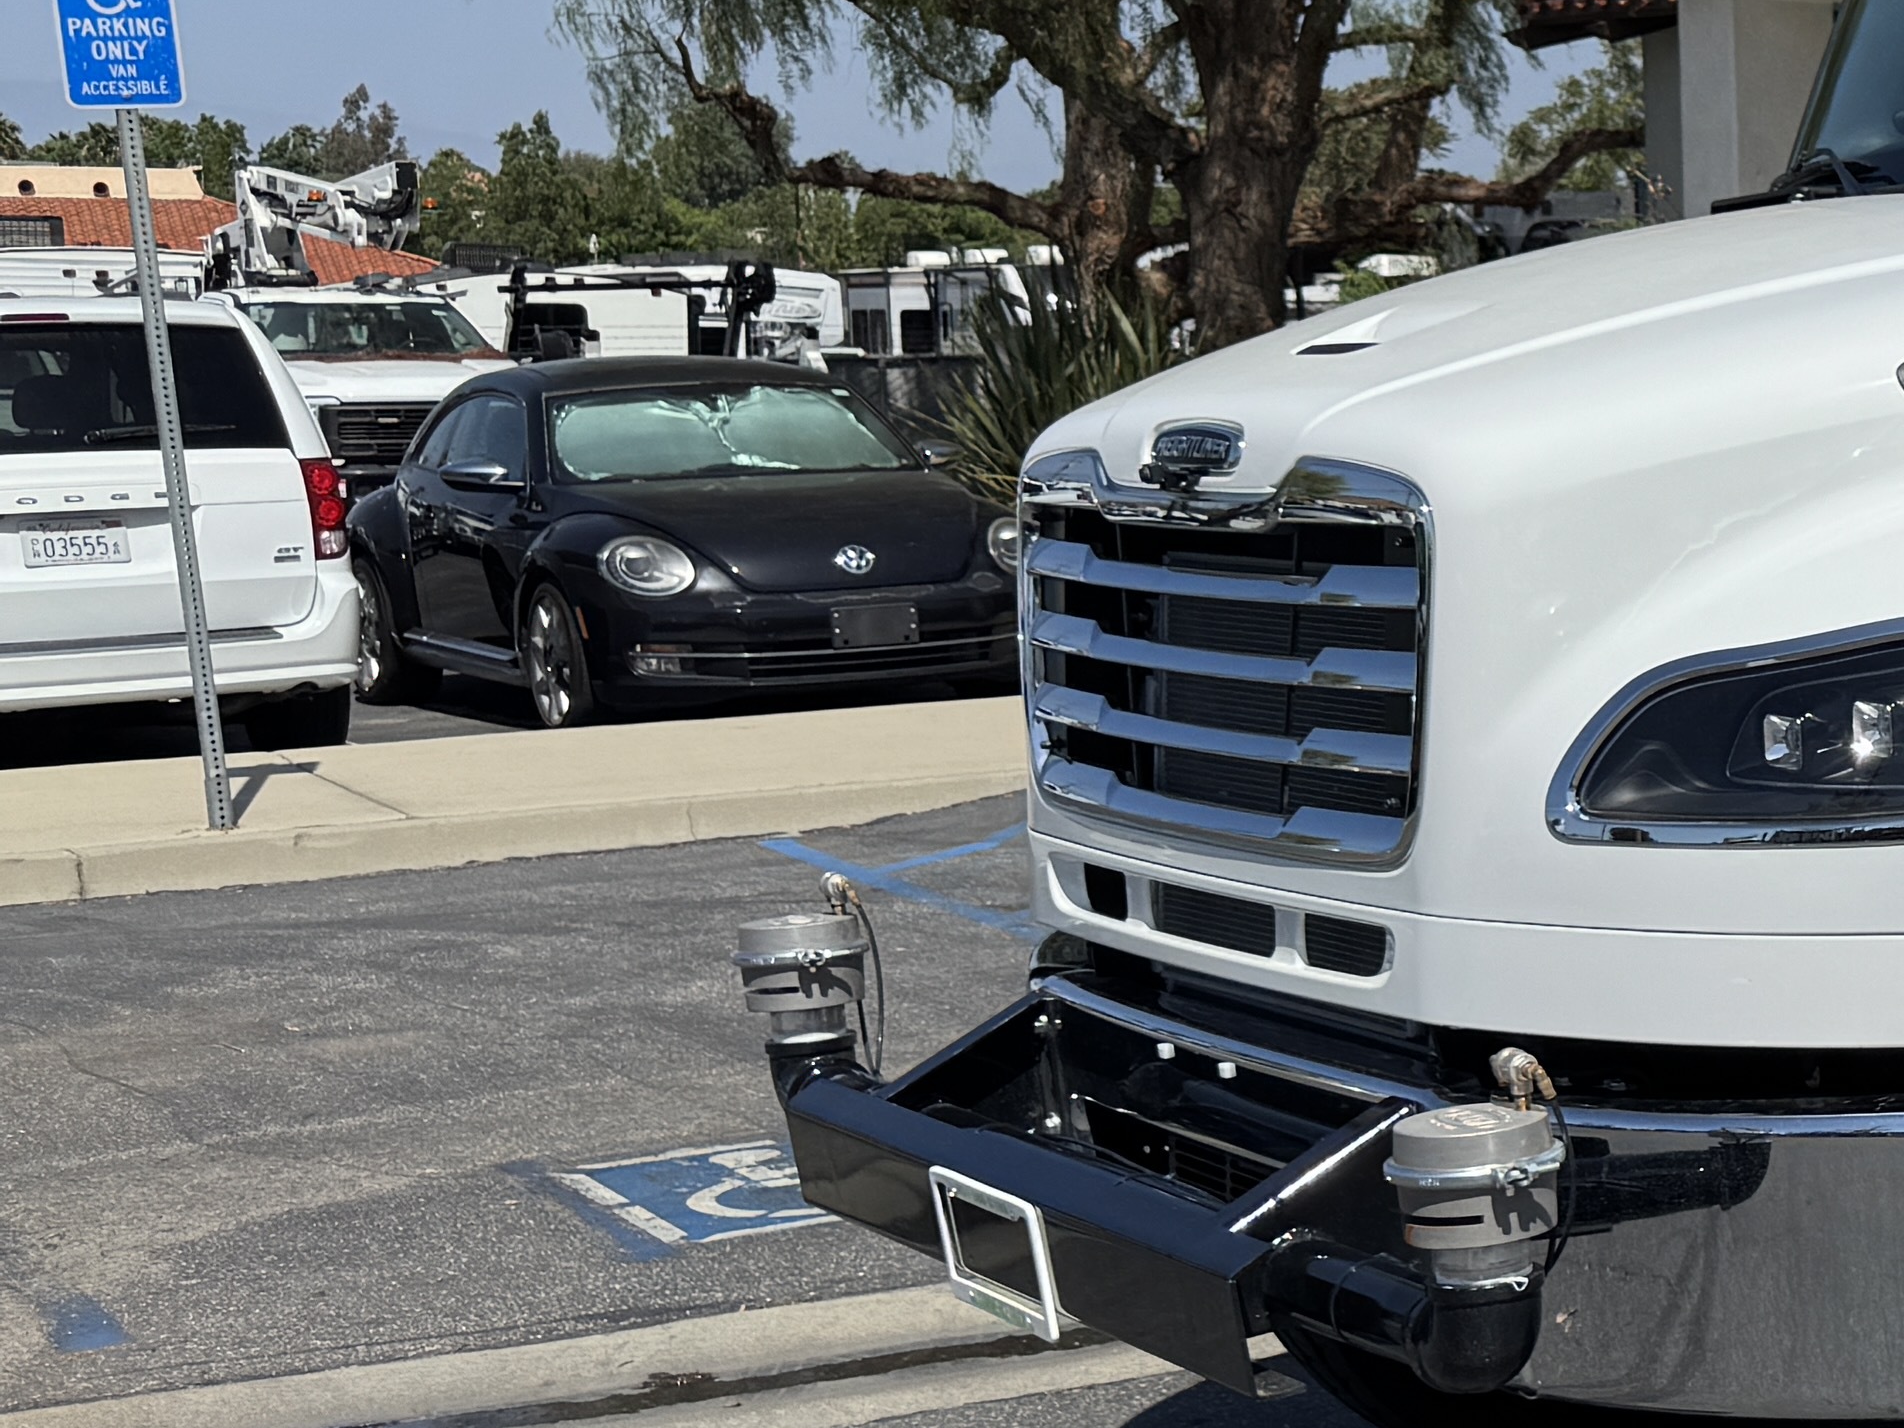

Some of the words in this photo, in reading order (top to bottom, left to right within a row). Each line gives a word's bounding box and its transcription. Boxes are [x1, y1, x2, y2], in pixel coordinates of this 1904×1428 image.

[67, 17, 167, 37] PARKING
[91, 40, 148, 60] ONLY
[109, 64, 137, 78] VAN
[82, 79, 169, 95] ACCESSIBLE
[43, 535, 109, 558] 03555
